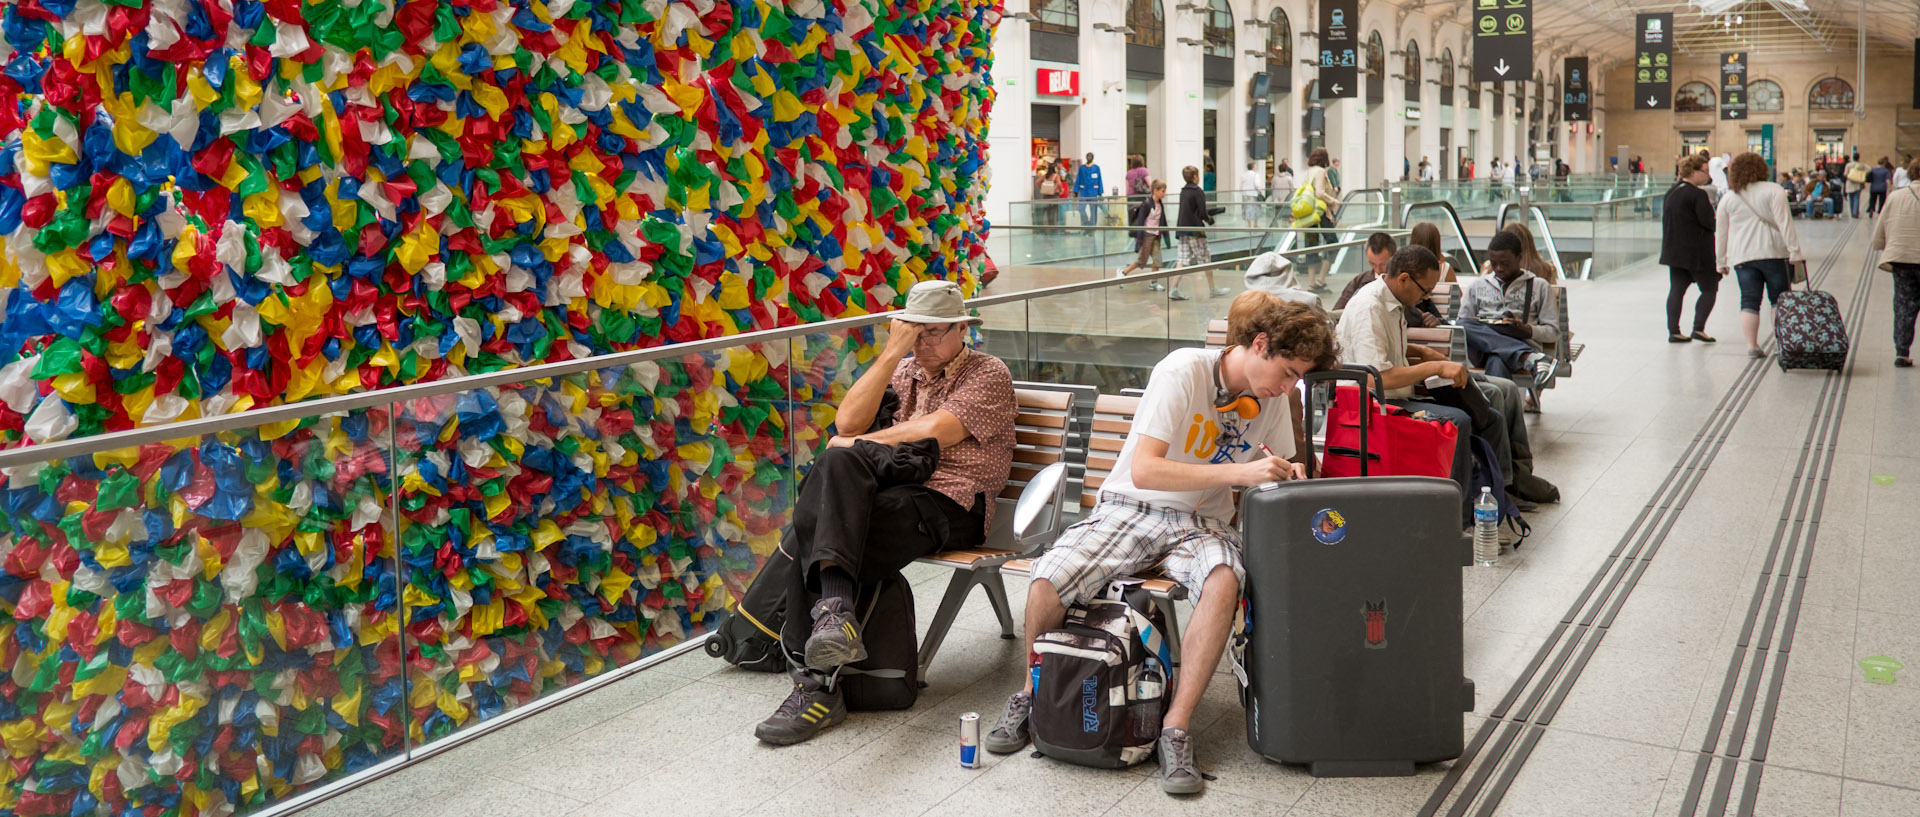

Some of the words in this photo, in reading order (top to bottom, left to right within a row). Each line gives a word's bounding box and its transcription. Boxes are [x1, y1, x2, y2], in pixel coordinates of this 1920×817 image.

[1320, 55, 1334, 65] 16
[1342, 54, 1356, 65] 21
[1049, 70, 1070, 92] RELAY
